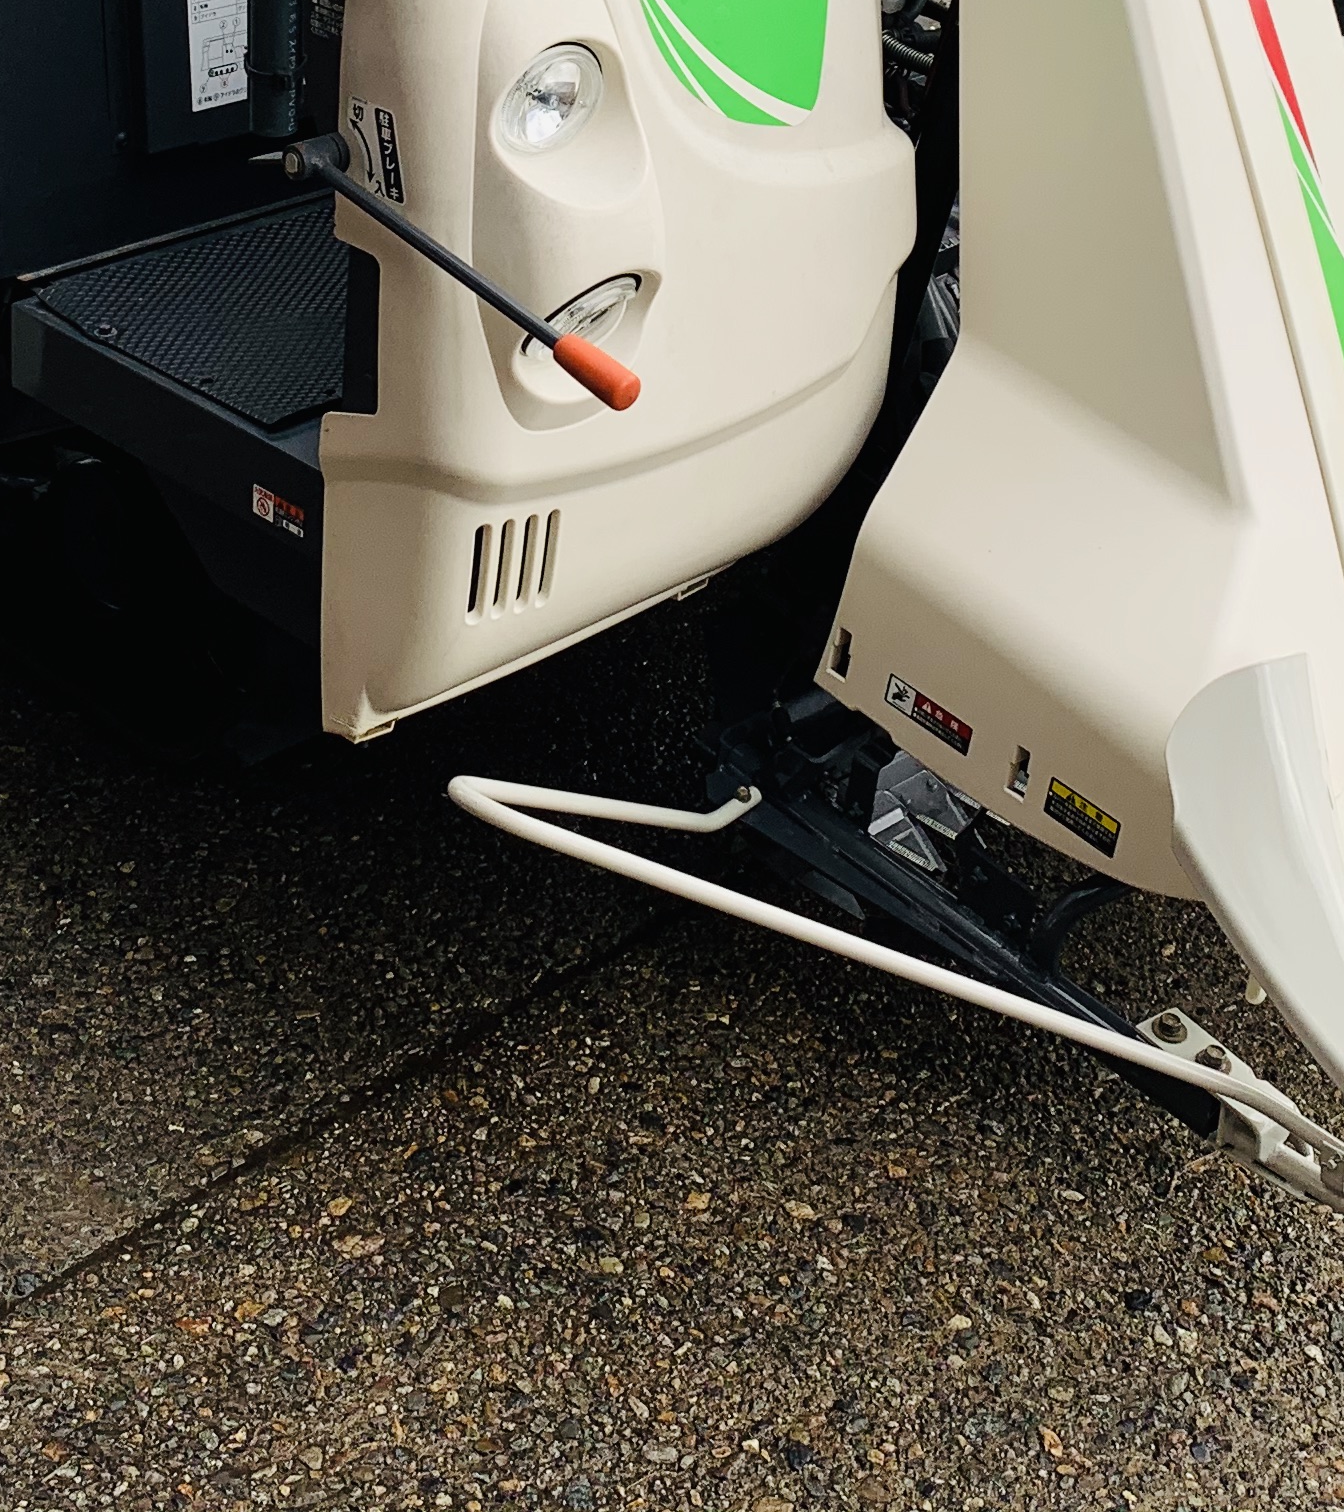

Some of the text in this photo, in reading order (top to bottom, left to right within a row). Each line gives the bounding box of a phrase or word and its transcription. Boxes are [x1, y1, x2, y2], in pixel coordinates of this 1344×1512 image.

[353, 103, 364, 122] 切
[379, 111, 399, 200] 駐車ブレーキ
[374, 179, 386, 198] 入
